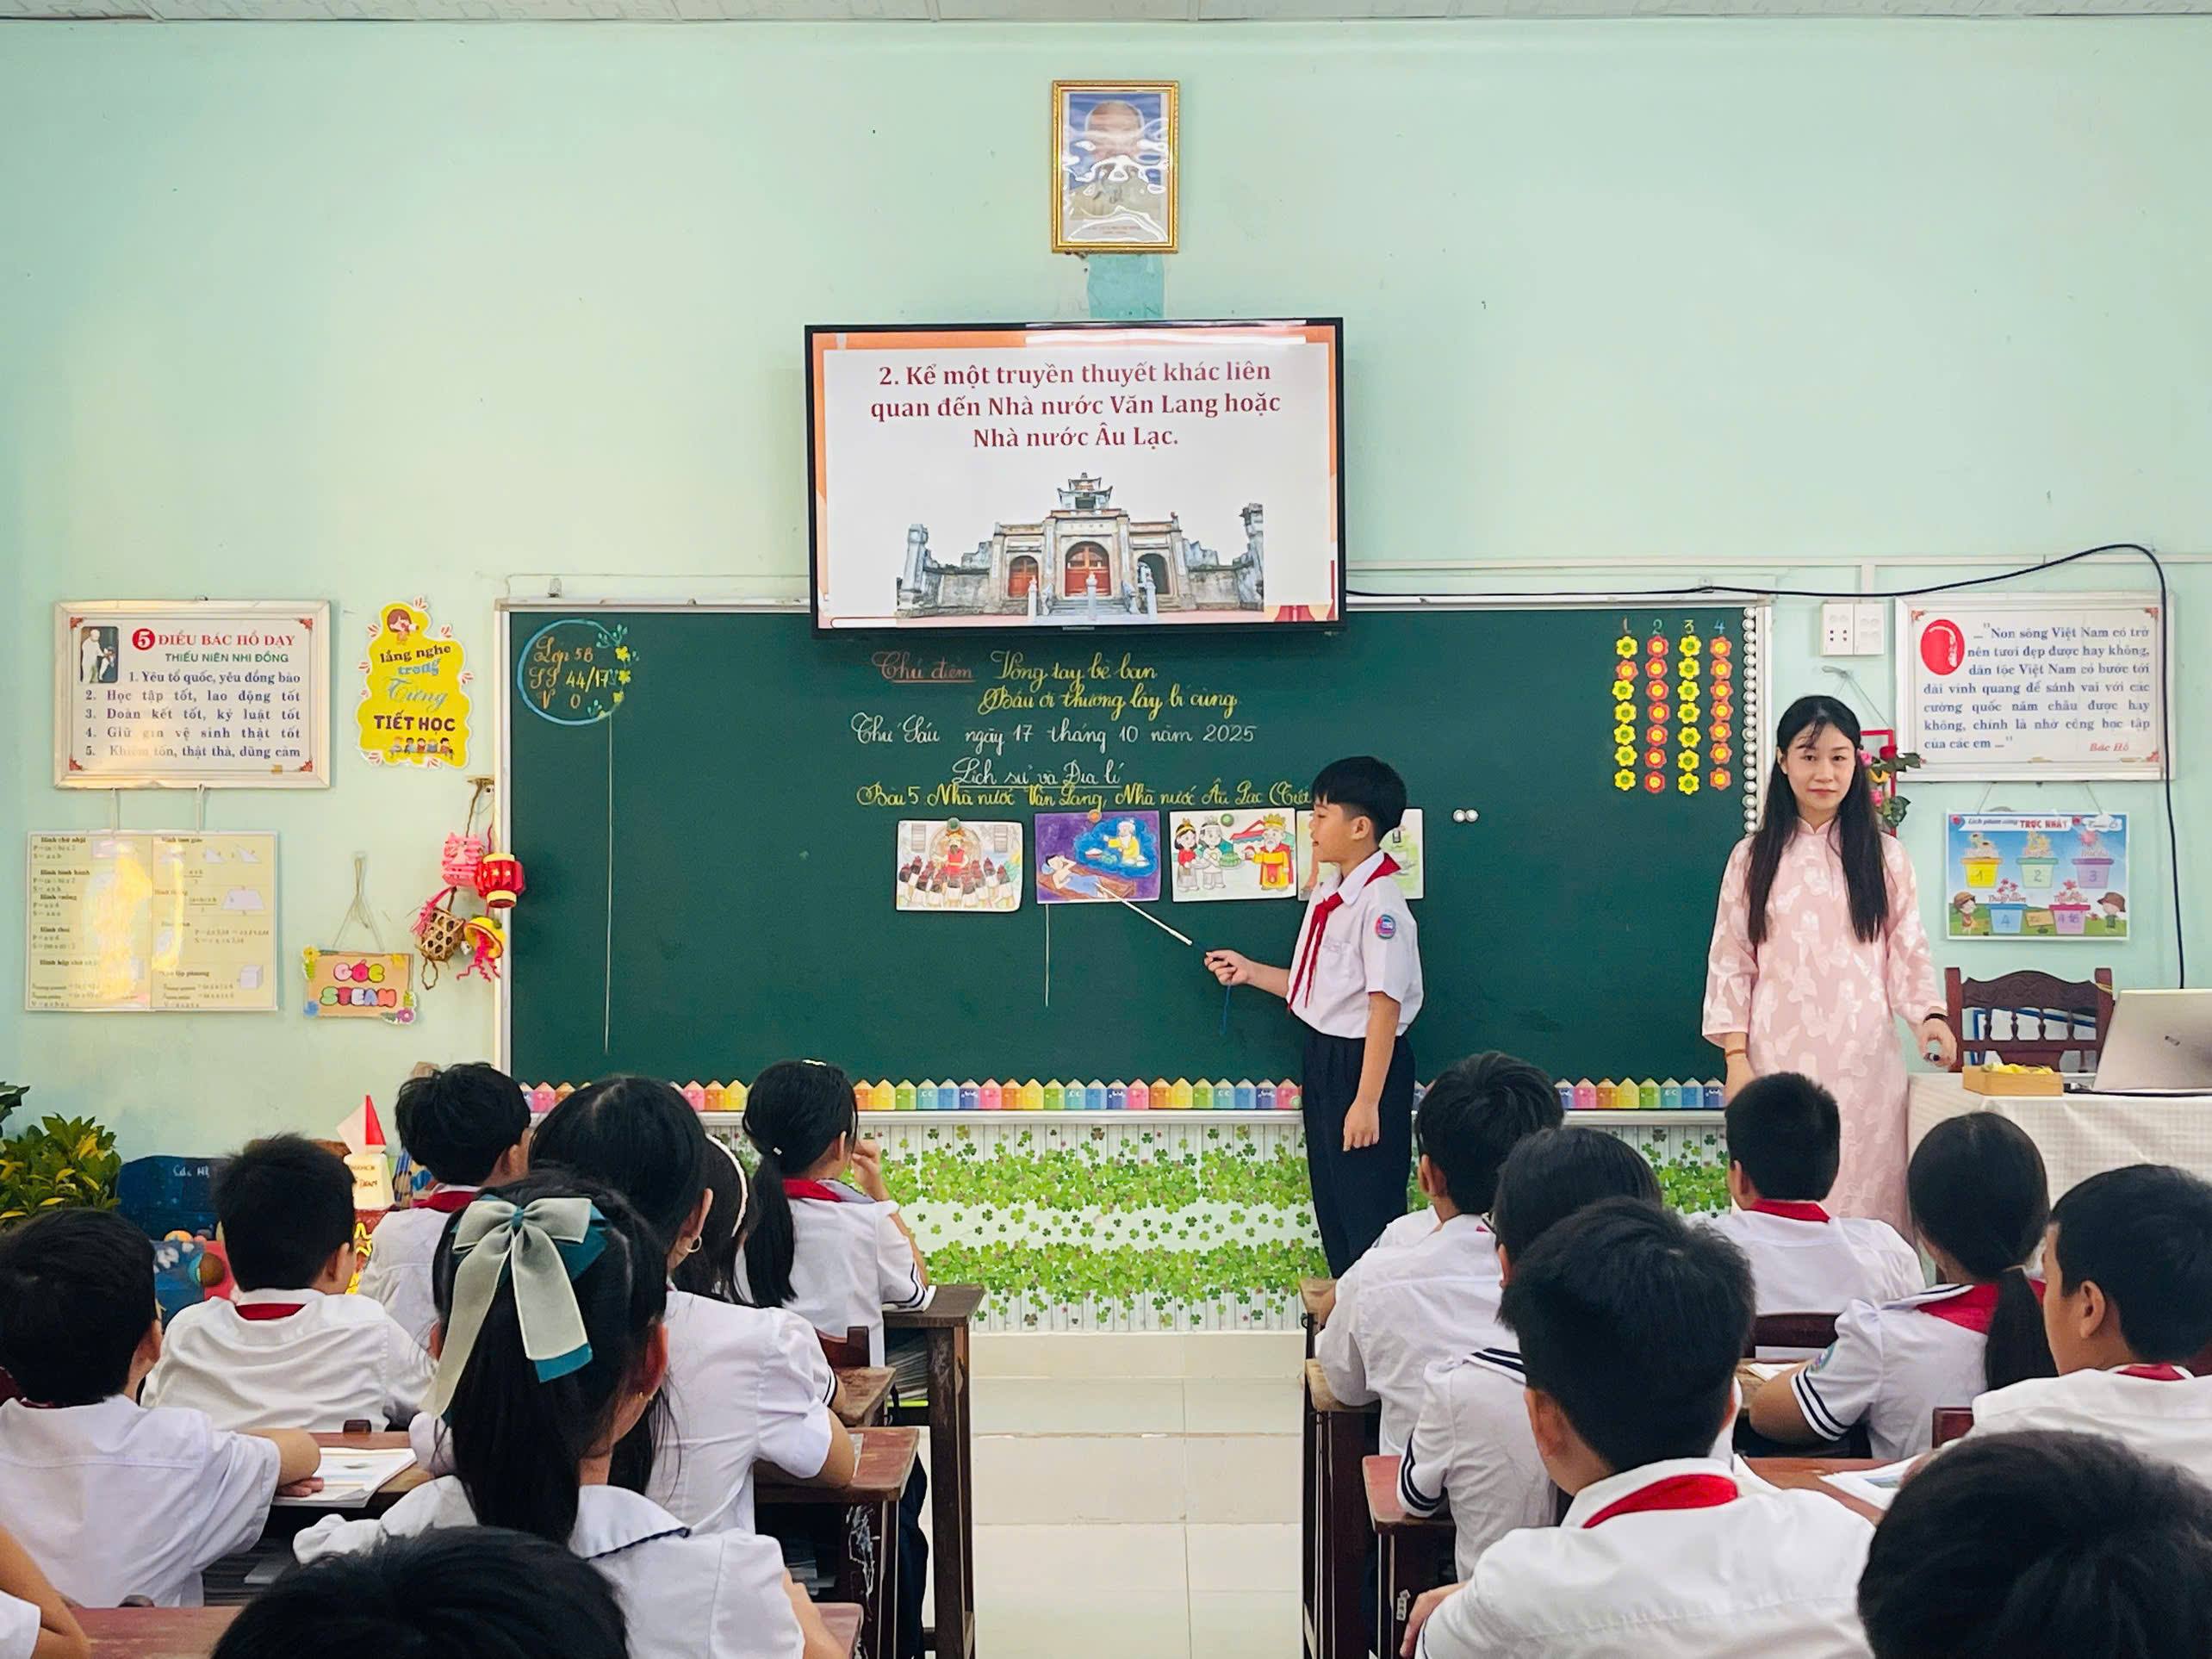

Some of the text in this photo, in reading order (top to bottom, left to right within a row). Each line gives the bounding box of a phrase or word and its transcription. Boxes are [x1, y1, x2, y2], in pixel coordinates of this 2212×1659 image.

[879, 360, 1271, 388] 2. Kể một truyền thuyết khác liên
[870, 392, 1281, 422] quan đến Nhà nước Văn Lang hoặc
[973, 422, 1178, 450] Nhà nước Âu Lạc.
[1622, 618, 1725, 635] 1 2 3 4
[2019, 628, 2048, 640] sông
[2052, 627, 2076, 641] Việt
[2081, 626, 2109, 637] Nam
[2112, 627, 2126, 637] có
[202, 631, 233, 646] BÁC
[237, 630, 260, 646] HỒ
[264, 634, 295, 649] DẠY
[165, 650, 289, 662] THIẾU NIÊN NHI ĐỒNG
[416, 644, 451, 659] nghe
[1967, 644, 2150, 658] nên tươi đẹp được hay không,
[398, 658, 441, 676] trong
[872, 651, 923, 680] Chủ
[1052, 662, 1085, 693] tay
[1115, 652, 1158, 683] bạn
[1968, 662, 2149, 678] dân tộc Việt Nam có bước tới
[129, 671, 138, 682] 1.
[142, 671, 165, 682] Yêu
[183, 669, 216, 686] quốc,
[219, 671, 241, 686] yêu
[245, 669, 276, 686] đồng
[278, 671, 301, 683] bào
[85, 688, 300, 704] 2. Học tập tốt, lao động tốt
[1948, 682, 1977, 693] vinh
[1982, 684, 2021, 695] quang
[2046, 681, 2075, 693] sánh
[2081, 681, 2099, 692] vai
[2105, 680, 2124, 693] với
[2129, 680, 2150, 693] các
[1060, 684, 1128, 721] thương
[1923, 699, 2150, 714] cường quốc năm châu được hay
[85, 708, 96, 719] 3.
[152, 706, 172, 719] kết
[183, 706, 206, 721] tốt,
[244, 708, 270, 723] luật
[282, 707, 300, 720] tốt
[373, 710, 456, 736] TIẾT HỌC
[85, 726, 300, 741] 4. Giữ vệ sinh thật tốt
[1923, 718, 2150, 732] không, chính là nhờ công học tập
[903, 713, 941, 743] Sáu
[964, 726, 1006, 756] ngày
[1013, 724, 1035, 743] 17
[1047, 718, 1107, 754] tháng
[1119, 725, 1139, 743] 10
[1151, 725, 1194, 743] năm
[1202, 724, 1258, 743] 2025
[1923, 737, 1991, 749] của các em
[85, 745, 96, 756] 5.
[183, 745, 207, 759] thật
[212, 745, 235, 758] thà,
[240, 745, 271, 759] dũng
[276, 745, 301, 757] cảm
[907, 786, 921, 805] 5
[926, 782, 974, 806] Nhà
[978, 786, 1016, 806] nước
[1027, 783, 1057, 806] Văn
[1115, 782, 1156, 806] Nhà
[1160, 785, 1197, 806] nước
[1201, 777, 1230, 805] Âu
[2034, 869, 2097, 883] 2 3
[320, 985, 398, 1008] STEAM
